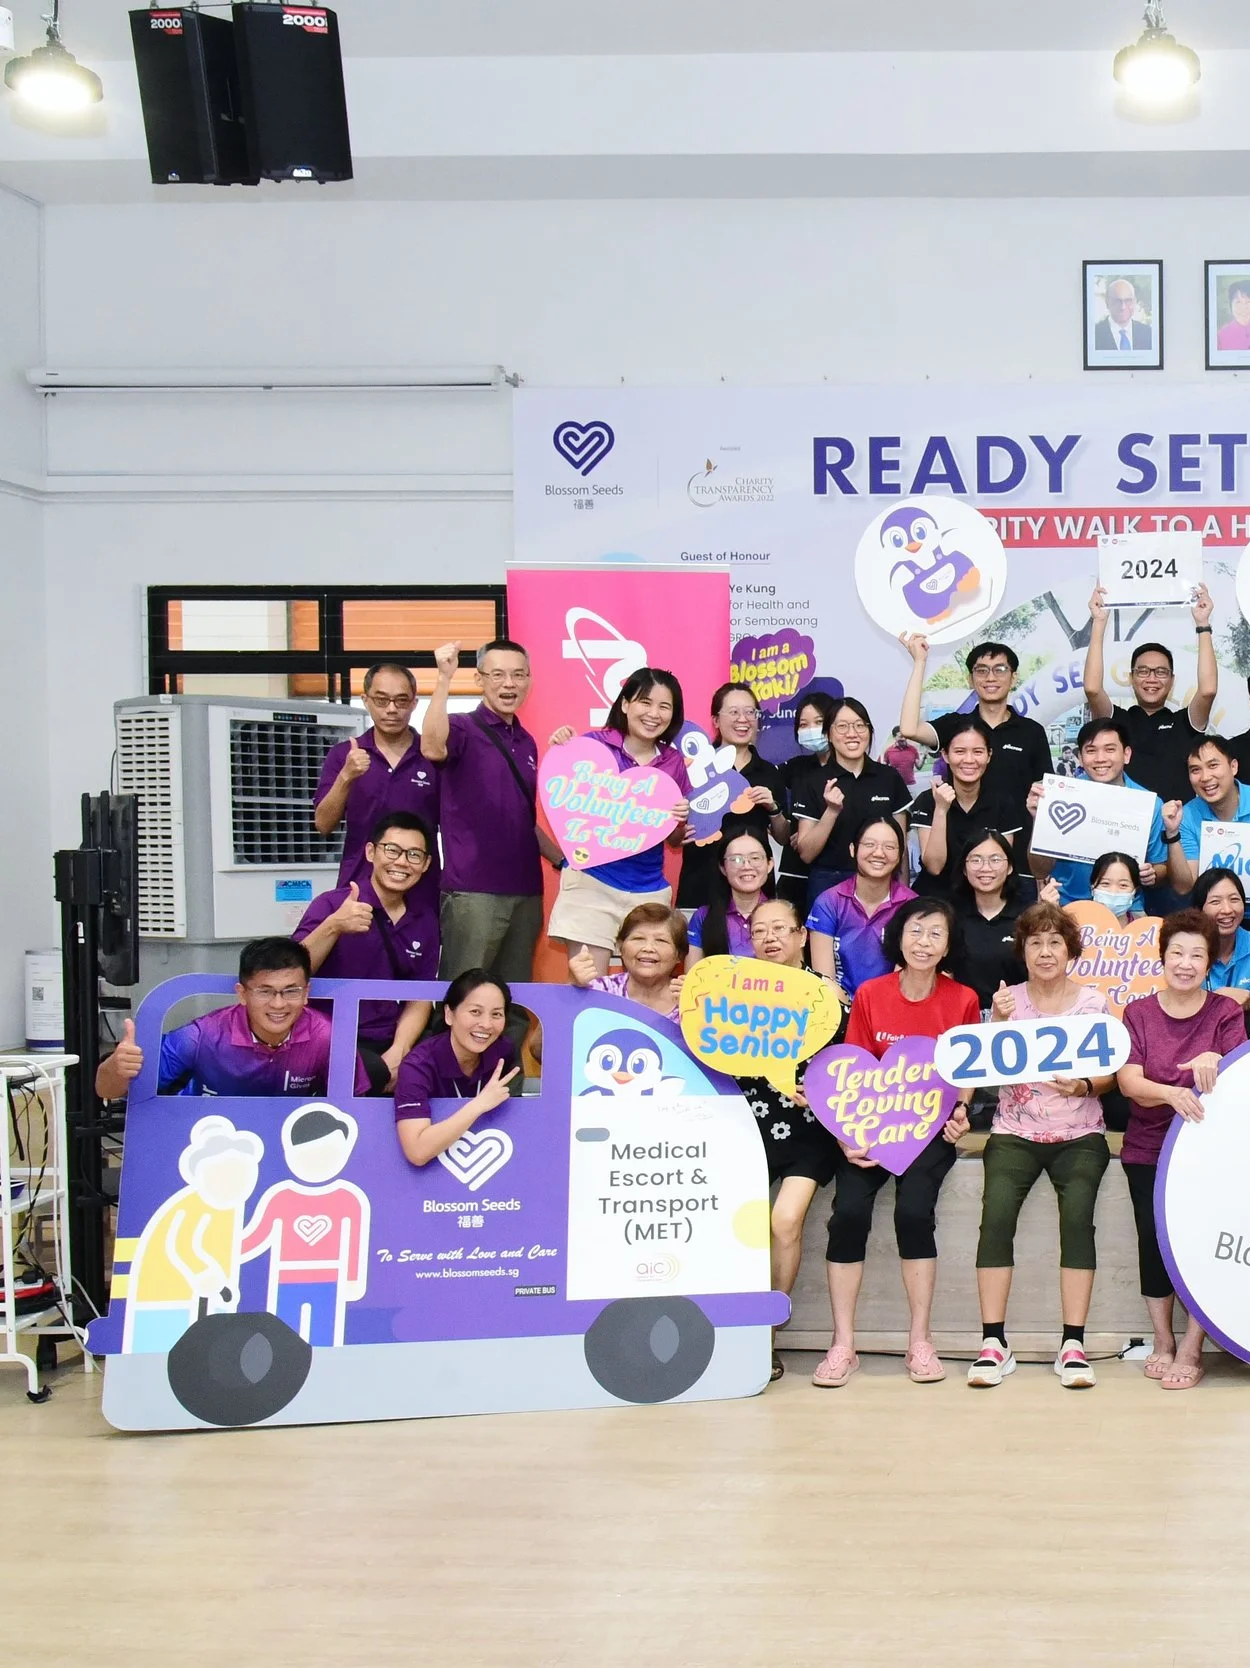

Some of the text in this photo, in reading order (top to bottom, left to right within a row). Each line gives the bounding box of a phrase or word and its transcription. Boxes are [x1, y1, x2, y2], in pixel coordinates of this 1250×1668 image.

[813, 434, 1082, 495] READY
[1116, 432, 1248, 495] SET
[545, 485, 624, 496] Blossom Seeds
[694, 486, 774, 494] TRANSPARENCY
[735, 477, 774, 485] CHARITY
[718, 494, 775, 502] AWARDS 2022
[1151, 515, 1194, 533] TO
[1203, 514, 1222, 539] A
[680, 551, 771, 562] Guest of Honour
[1121, 558, 1178, 579] 2024
[746, 584, 776, 595] Kung
[747, 600, 784, 610] Health
[787, 600, 810, 610] and
[745, 616, 818, 627] Sembawang
[751, 642, 790, 660] I am a
[730, 653, 808, 683] Blossom
[572, 760, 631, 799] Being
[631, 774, 658, 796] A
[545, 775, 670, 828] Volunteer
[1091, 816, 1140, 832] Blossom Seeds
[564, 818, 646, 851] Is Cool
[1080, 926, 1156, 957] Being A
[1065, 949, 1164, 983] Voluntee
[731, 973, 785, 993] I am a
[705, 996, 809, 1037] Happy
[699, 1027, 803, 1059] Senior
[949, 1021, 1116, 1080] 2024
[827, 1055, 938, 1093] Tender
[827, 1084, 942, 1123] Loving
[842, 1115, 931, 1148] Care
[611, 1141, 707, 1161] Medical
[609, 1168, 708, 1188] Escort &
[423, 1198, 521, 1214] Blossom Seeds
[598, 1193, 719, 1216] Transport
[457, 1215, 485, 1229] 福善
[624, 1217, 694, 1245] (MET)
[376, 1244, 558, 1263] To Serve with Love and Care
[415, 1266, 520, 1280] www.blossomseeds.sg
[515, 1285, 556, 1296] PRIVATE BUS
